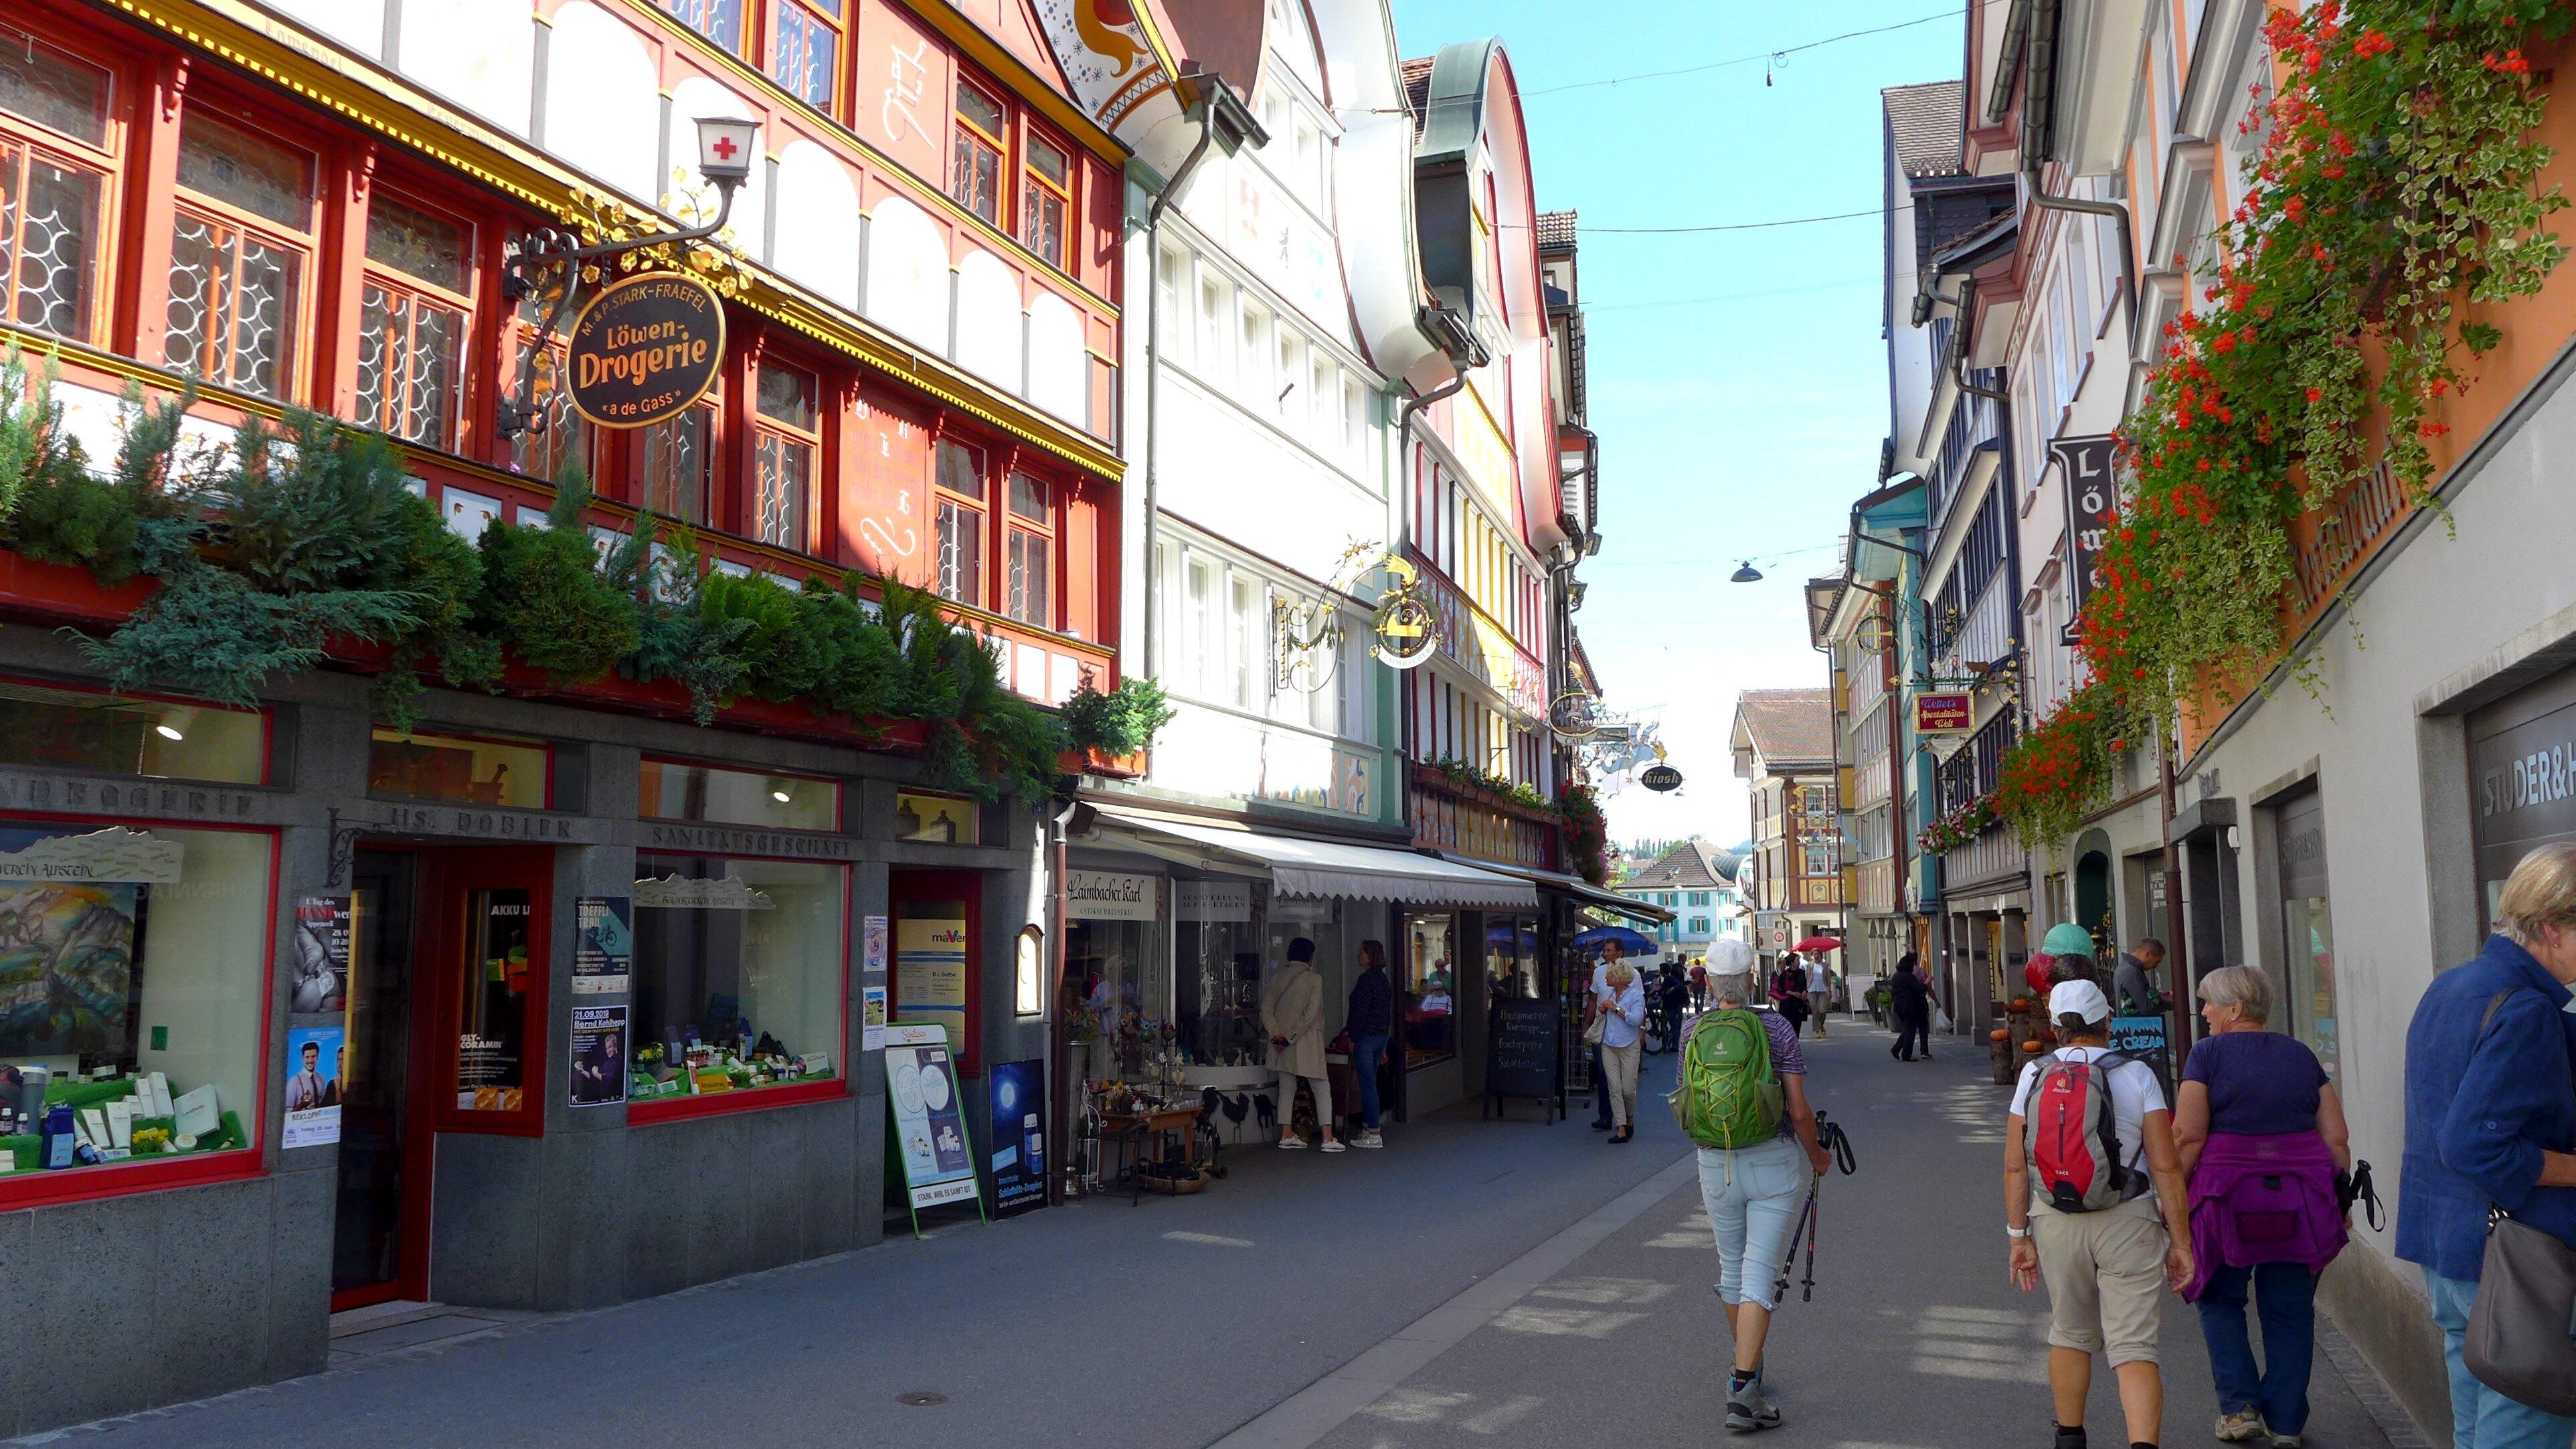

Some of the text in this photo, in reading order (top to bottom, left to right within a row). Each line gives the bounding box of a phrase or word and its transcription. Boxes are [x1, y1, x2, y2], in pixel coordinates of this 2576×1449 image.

[612, 284, 707, 313] STARK-FRAEFEL
[607, 320, 685, 350] Löwen-
[580, 331, 707, 389] Drogerie
[621, 402, 637, 416] de
[1383, 648, 1433, 666] LAIMBACHER
[458, 812, 570, 837] DOBLER
[1067, 873, 1145, 904] Laimbacher Karl
[490, 904, 520, 916] AKKU
[578, 906, 609, 917] TOEFFLI
[578, 917, 602, 928] TRAIL
[574, 1009, 609, 1019] 21.09.2019
[574, 1020, 598, 1029] Bernd
[460, 1034, 481, 1042] GLY-
[460, 1040, 503, 1049] CORAMIN
